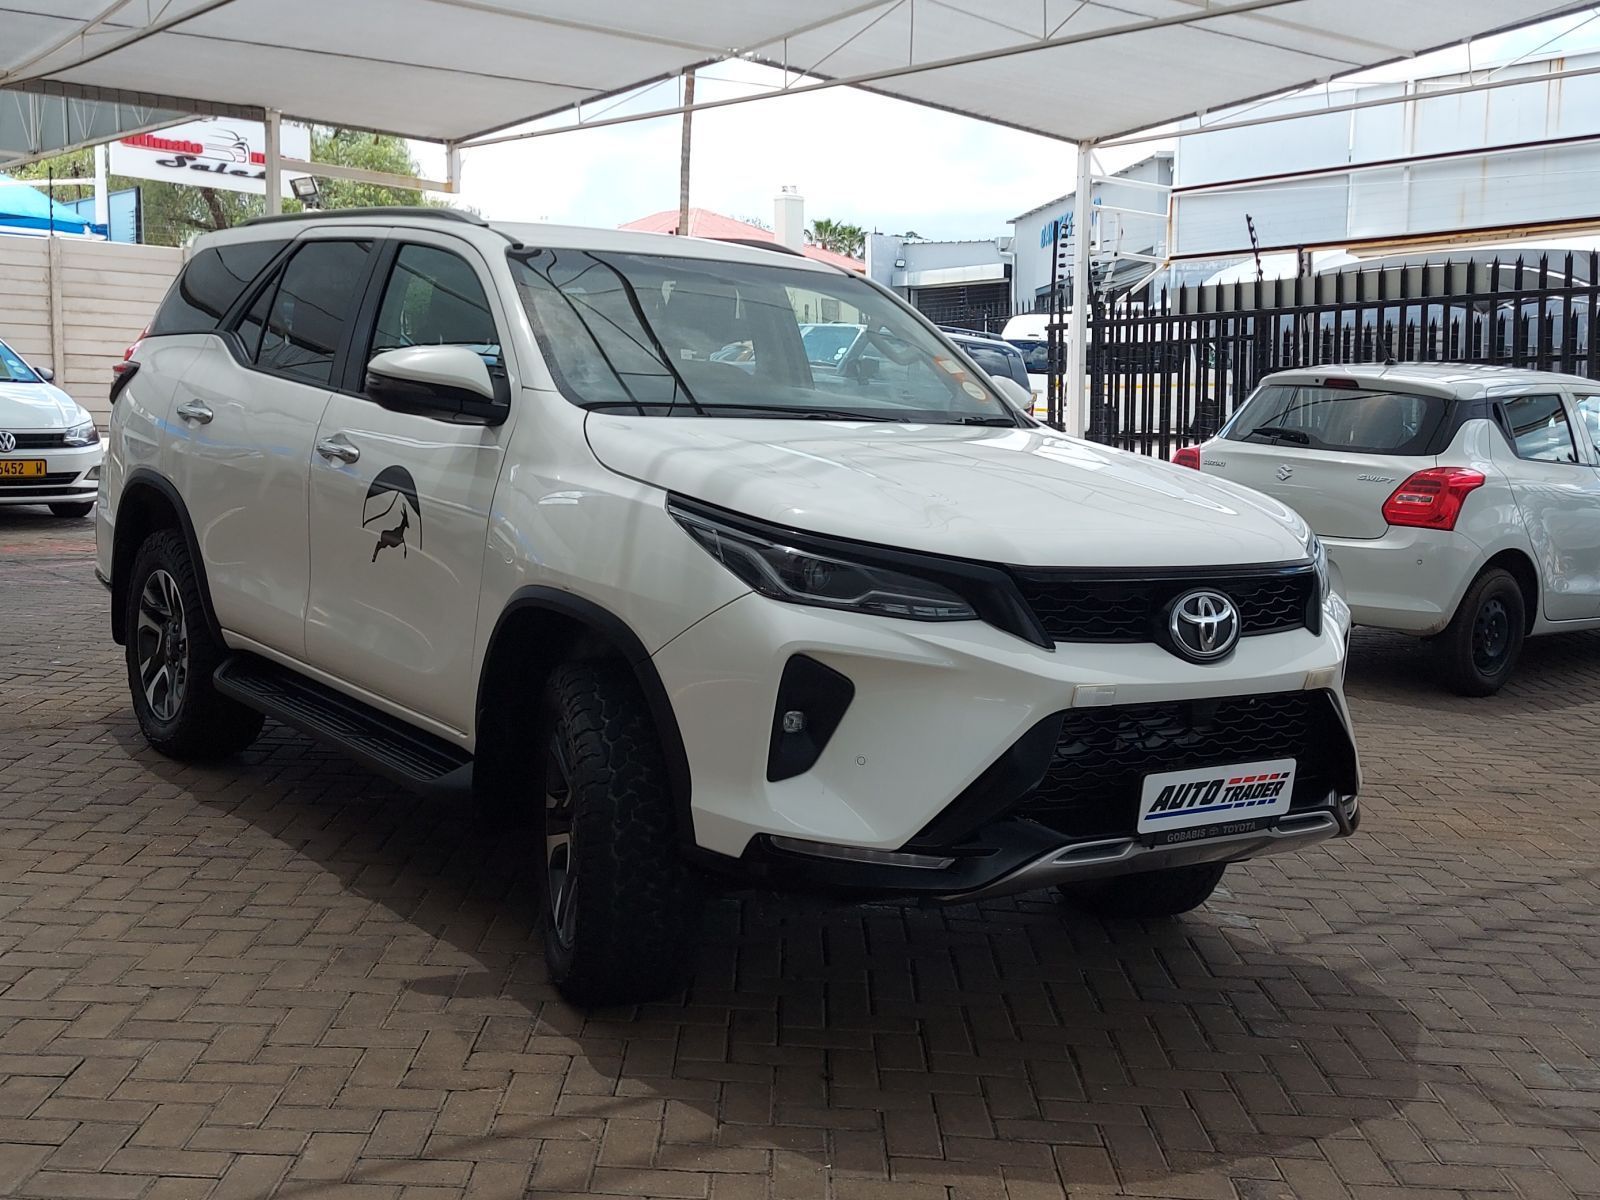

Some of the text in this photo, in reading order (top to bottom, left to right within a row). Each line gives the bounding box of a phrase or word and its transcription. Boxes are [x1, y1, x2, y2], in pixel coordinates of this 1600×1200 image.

[35, 461, 43, 475] W
[1357, 473, 1397, 484] SWIFT
[1149, 779, 1286, 812] AUTO TRADER
[1167, 822, 1256, 842] GOBABIS TOYOTA
